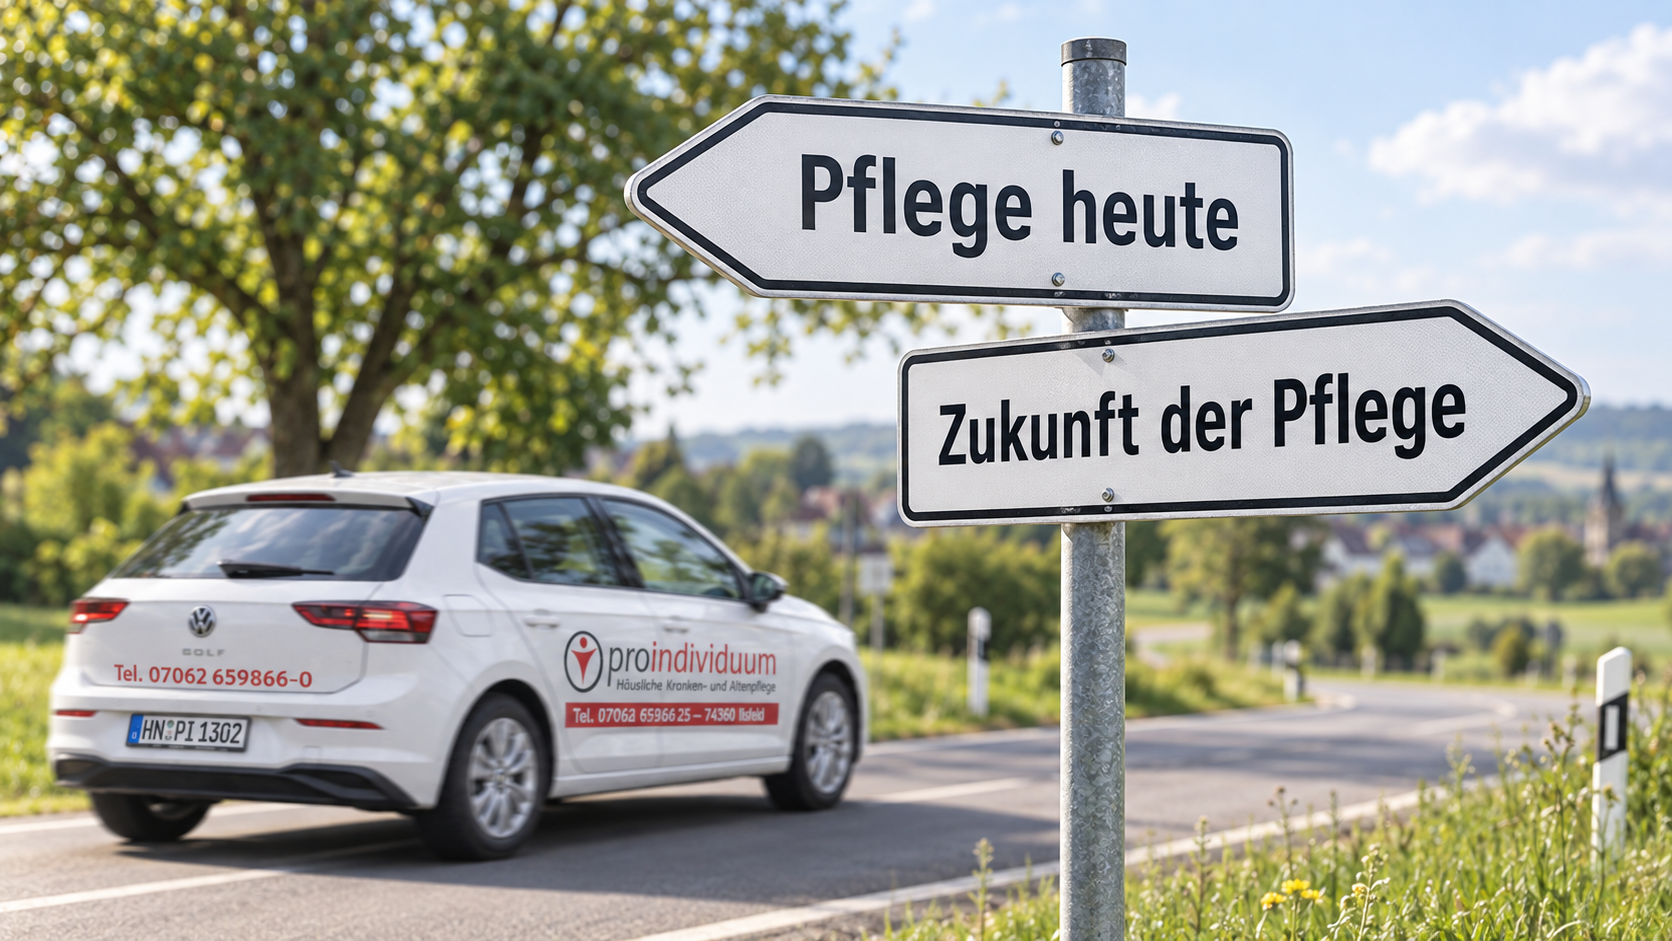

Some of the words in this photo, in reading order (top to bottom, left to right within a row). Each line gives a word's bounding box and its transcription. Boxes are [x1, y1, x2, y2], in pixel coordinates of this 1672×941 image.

[800, 154, 1033, 258] Pflege
[1062, 170, 1239, 250] heute
[938, 391, 1140, 465] Zukunft
[1161, 385, 1253, 452] der
[1273, 373, 1467, 459] Pflege
[182, 649, 225, 657] GOLF
[607, 641, 776, 687] proindividuum
[114, 664, 143, 682] Tel.
[149, 666, 207, 685] 07062
[212, 669, 313, 689] 659866-0
[616, 678, 662, 691] Häusliche
[666, 679, 707, 691] Kranken-
[710, 681, 727, 692] und
[729, 680, 776, 695] Altenpflege
[573, 708, 594, 723] Tel.
[704, 707, 736, 722] 74360
[142, 719, 165, 740] HN
[174, 720, 195, 741] PI
[198, 721, 242, 744] 1302
